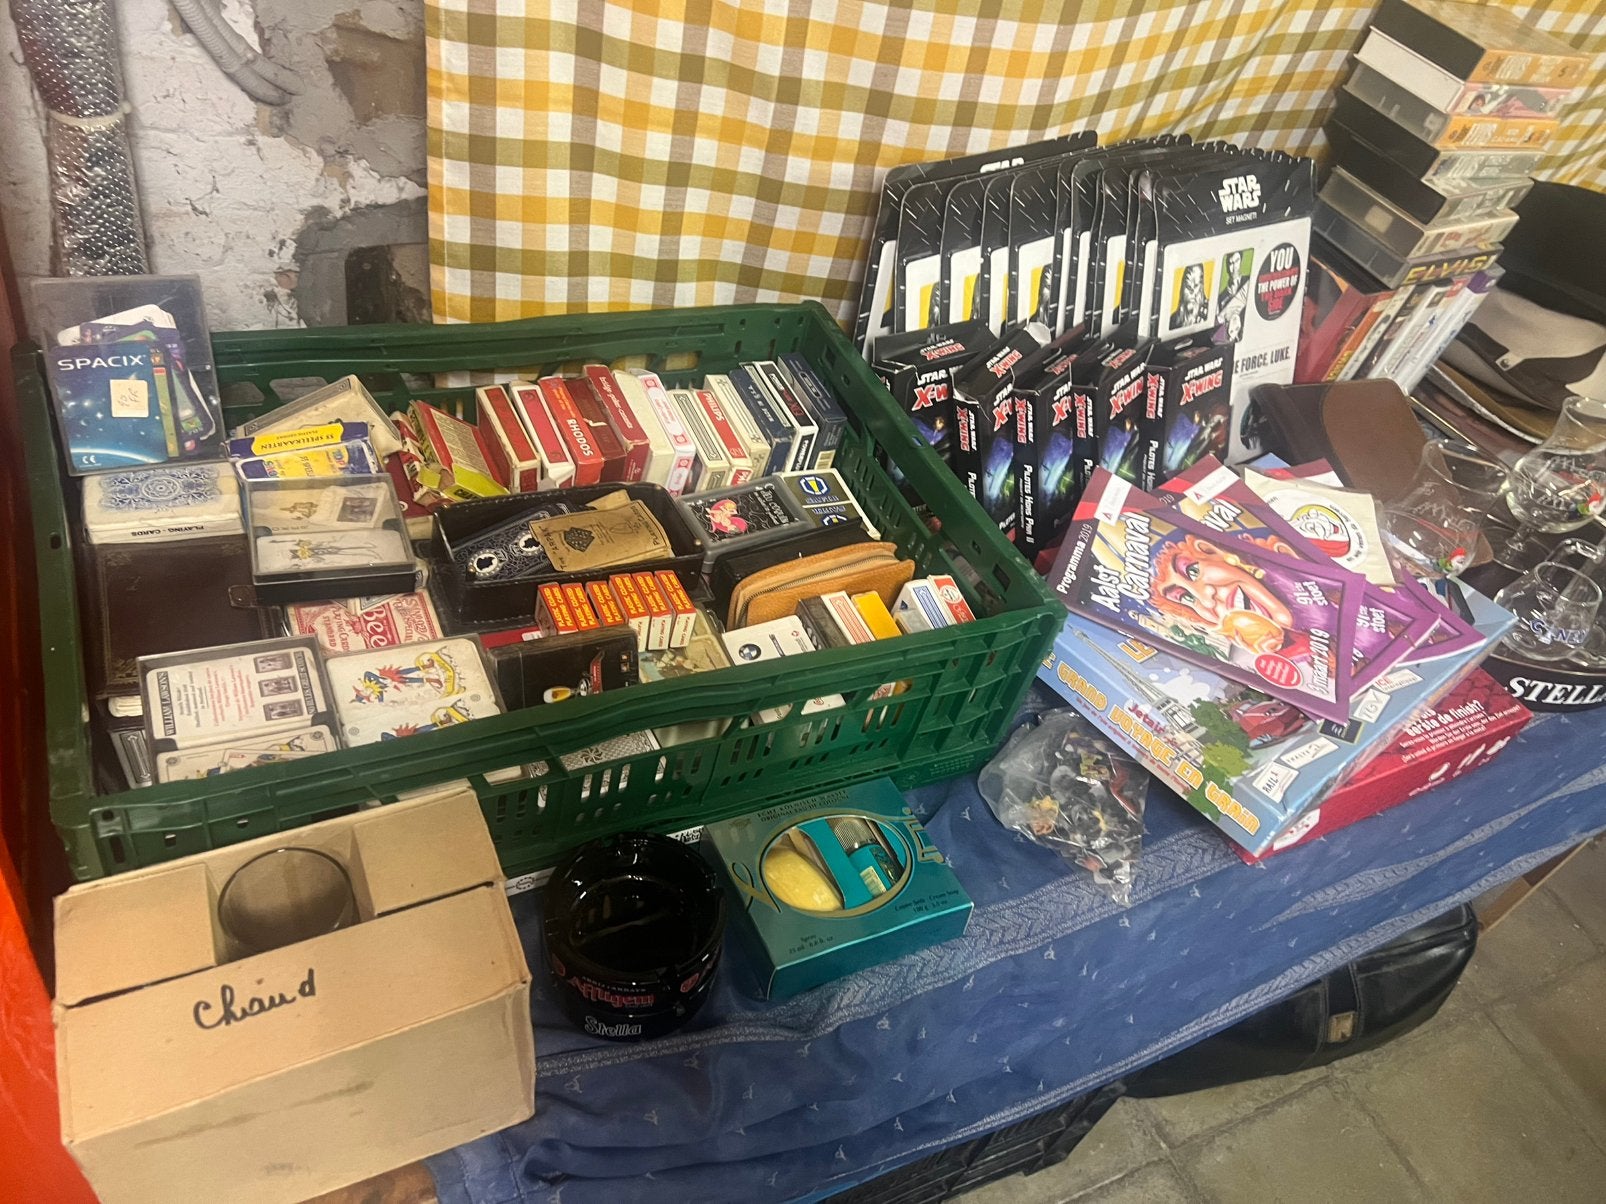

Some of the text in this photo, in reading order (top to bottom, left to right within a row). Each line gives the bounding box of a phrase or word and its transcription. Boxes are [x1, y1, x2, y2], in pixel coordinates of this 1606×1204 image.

[1219, 174, 1261, 194] STAR
[1220, 190, 1262, 213] WARS
[1270, 246, 1294, 273] YOU
[1257, 275, 1298, 295] THE POWER OF
[57, 355, 145, 371] SPACIX
[1184, 365, 1204, 382] STAR
[1203, 357, 1224, 373] WARS
[1240, 352, 1269, 373] FORCE,
[1270, 346, 1291, 365] LUKE.
[917, 371, 948, 386] STAR
[1111, 362, 1147, 395] STAR WAR
[1179, 369, 1224, 406] X-WING
[702, 393, 725, 422] PHILIPS
[912, 383, 949, 412] X-W
[1109, 376, 1144, 420] X-WIN
[1146, 372, 1160, 420] X-WING
[956, 405, 970, 452] X-WING
[1014, 397, 1027, 444] X-WING
[1074, 393, 1087, 439] X-WING
[260, 435, 325, 451] SPEELKAARTEN
[567, 418, 594, 457] RHODOS
[1148, 440, 1159, 471] PILOTES
[967, 472, 977, 498] PILOT
[1023, 464, 1033, 498] PILOTES
[1084, 458, 1095, 484] PILO
[130, 525, 204, 537] PLAYING CARDS
[1056, 523, 1094, 594] Programma 2019
[1116, 512, 1150, 602] Carnaval
[601, 584, 622, 621] PLAYING CARDS
[623, 577, 645, 613] PLAYING CARDS
[645, 576, 667, 611] PLAYING CARDS
[668, 574, 692, 609] PLAYING CARDS
[671, 593, 685, 610] PLASTIC
[1090, 563, 1121, 613] Aalst
[1303, 581, 1329, 606] stoet
[552, 587, 573, 626] PLAYING CARDS
[552, 607, 566, 627] PLASTIC
[575, 587, 596, 625] PLAYING CARDS
[575, 607, 588, 627] PLASTIC
[601, 604, 614, 623] PLASTIC
[624, 596, 638, 615] PLASTIC
[646, 594, 660, 613] PLASTIC
[363, 604, 388, 649] Bee
[1369, 607, 1386, 633] stoet
[339, 632, 350, 651] CARD
[1309, 628, 1330, 657] 2019
[1312, 653, 1329, 687] maart
[1375, 678, 1390, 687] ICE
[161, 705, 176, 735] WILLIAM
[1057, 661, 1108, 712] GRAND
[1107, 704, 1178, 767] VOYAGE
[1128, 703, 1165, 735] Jetair
[1437, 712, 1454, 726] de
[1448, 699, 1484, 721] finish?
[1262, 777, 1279, 794] RAIL
[584, 1015, 642, 1037] Stella
